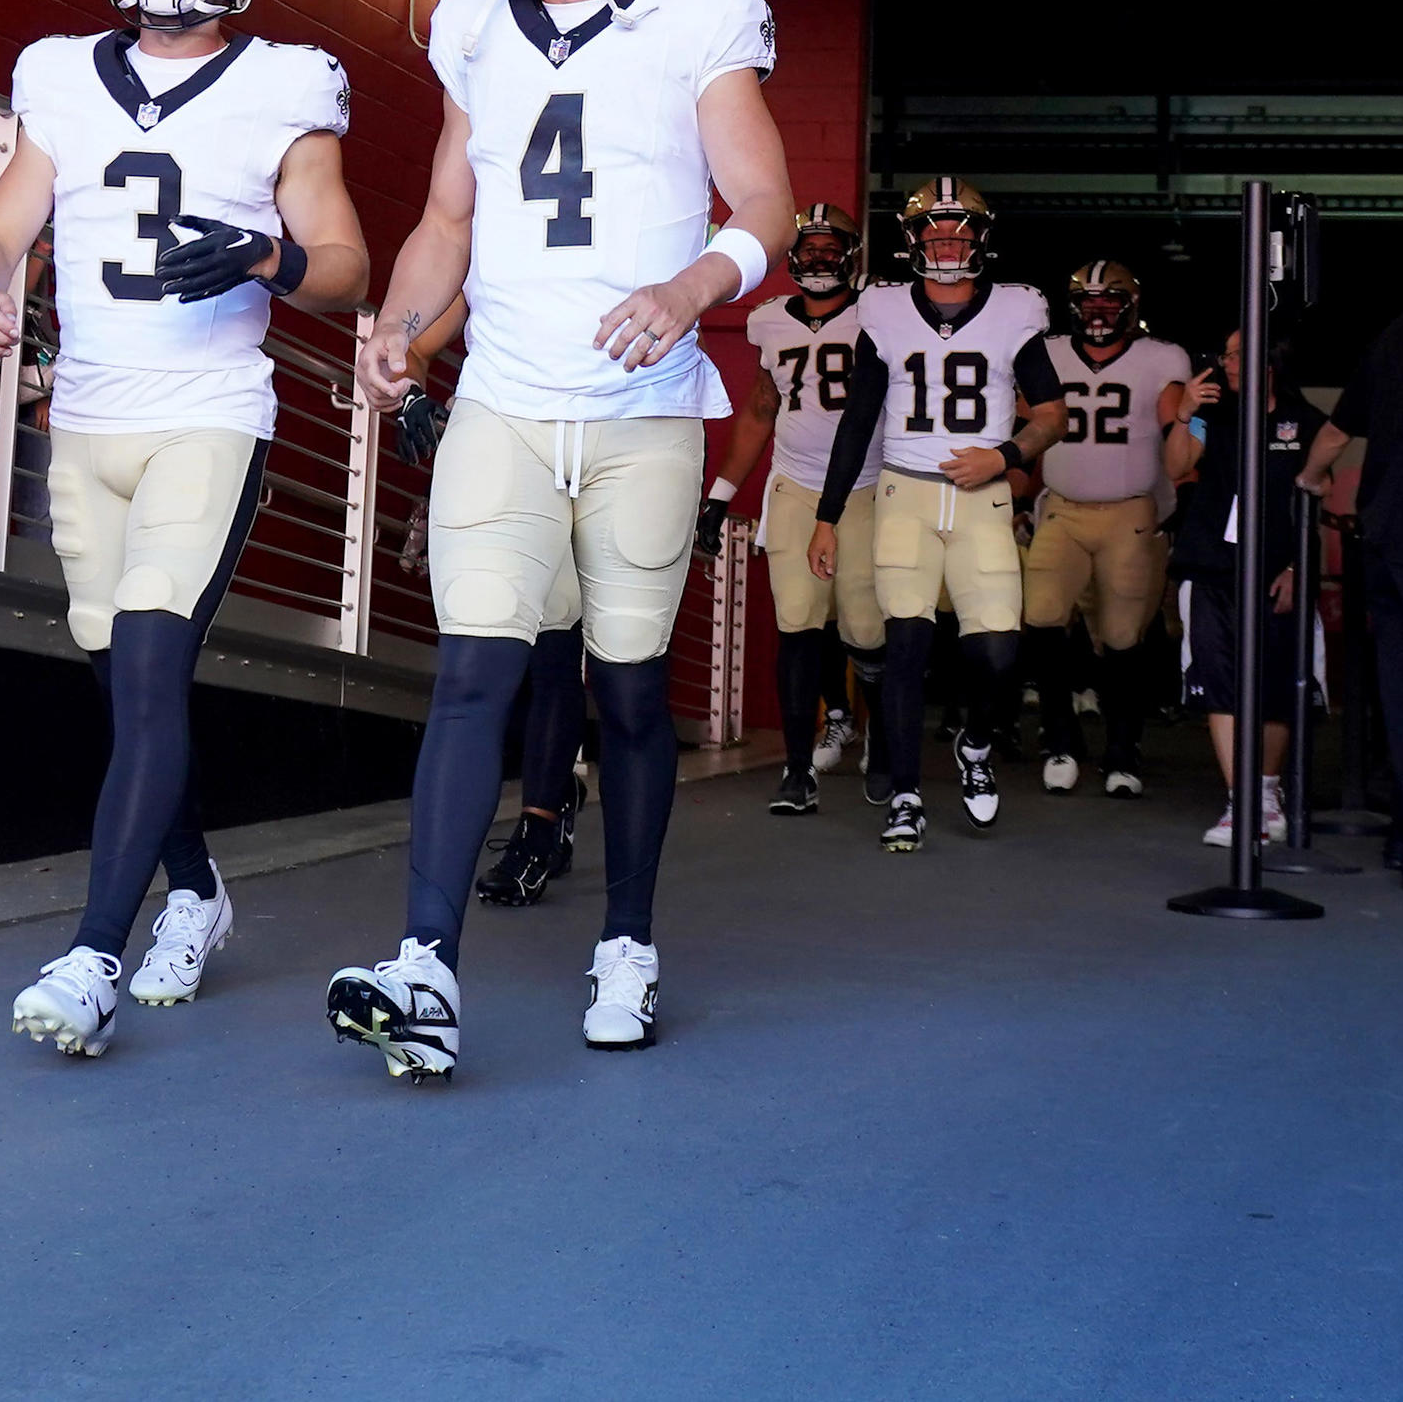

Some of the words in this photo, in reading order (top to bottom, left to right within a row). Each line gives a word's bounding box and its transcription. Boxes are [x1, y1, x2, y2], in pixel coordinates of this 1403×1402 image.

[517, 89, 597, 251] 4
[100, 149, 183, 304] 3
[777, 343, 855, 411] 78
[904, 351, 988, 433] 18
[1061, 381, 1131, 444] 62
